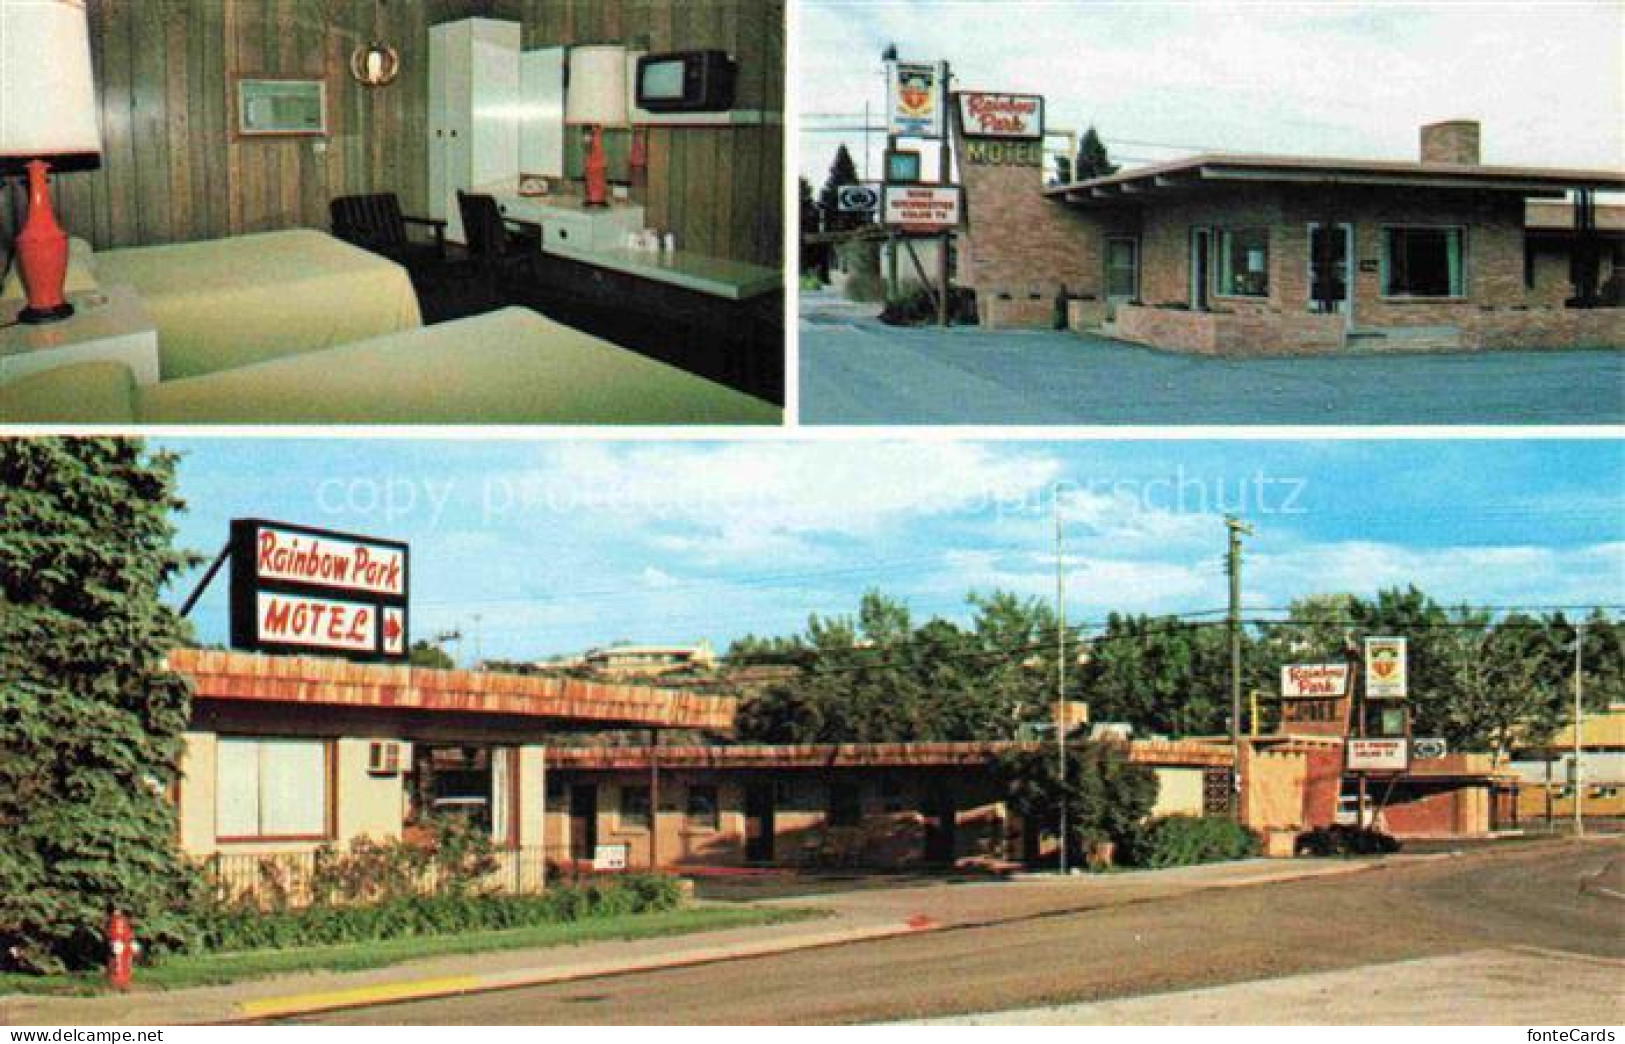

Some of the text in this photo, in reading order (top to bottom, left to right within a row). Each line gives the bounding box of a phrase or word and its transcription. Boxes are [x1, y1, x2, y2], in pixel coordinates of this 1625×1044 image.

[259, 531, 400, 590] Rainbow Park
[264, 599, 368, 642] MOTEL
